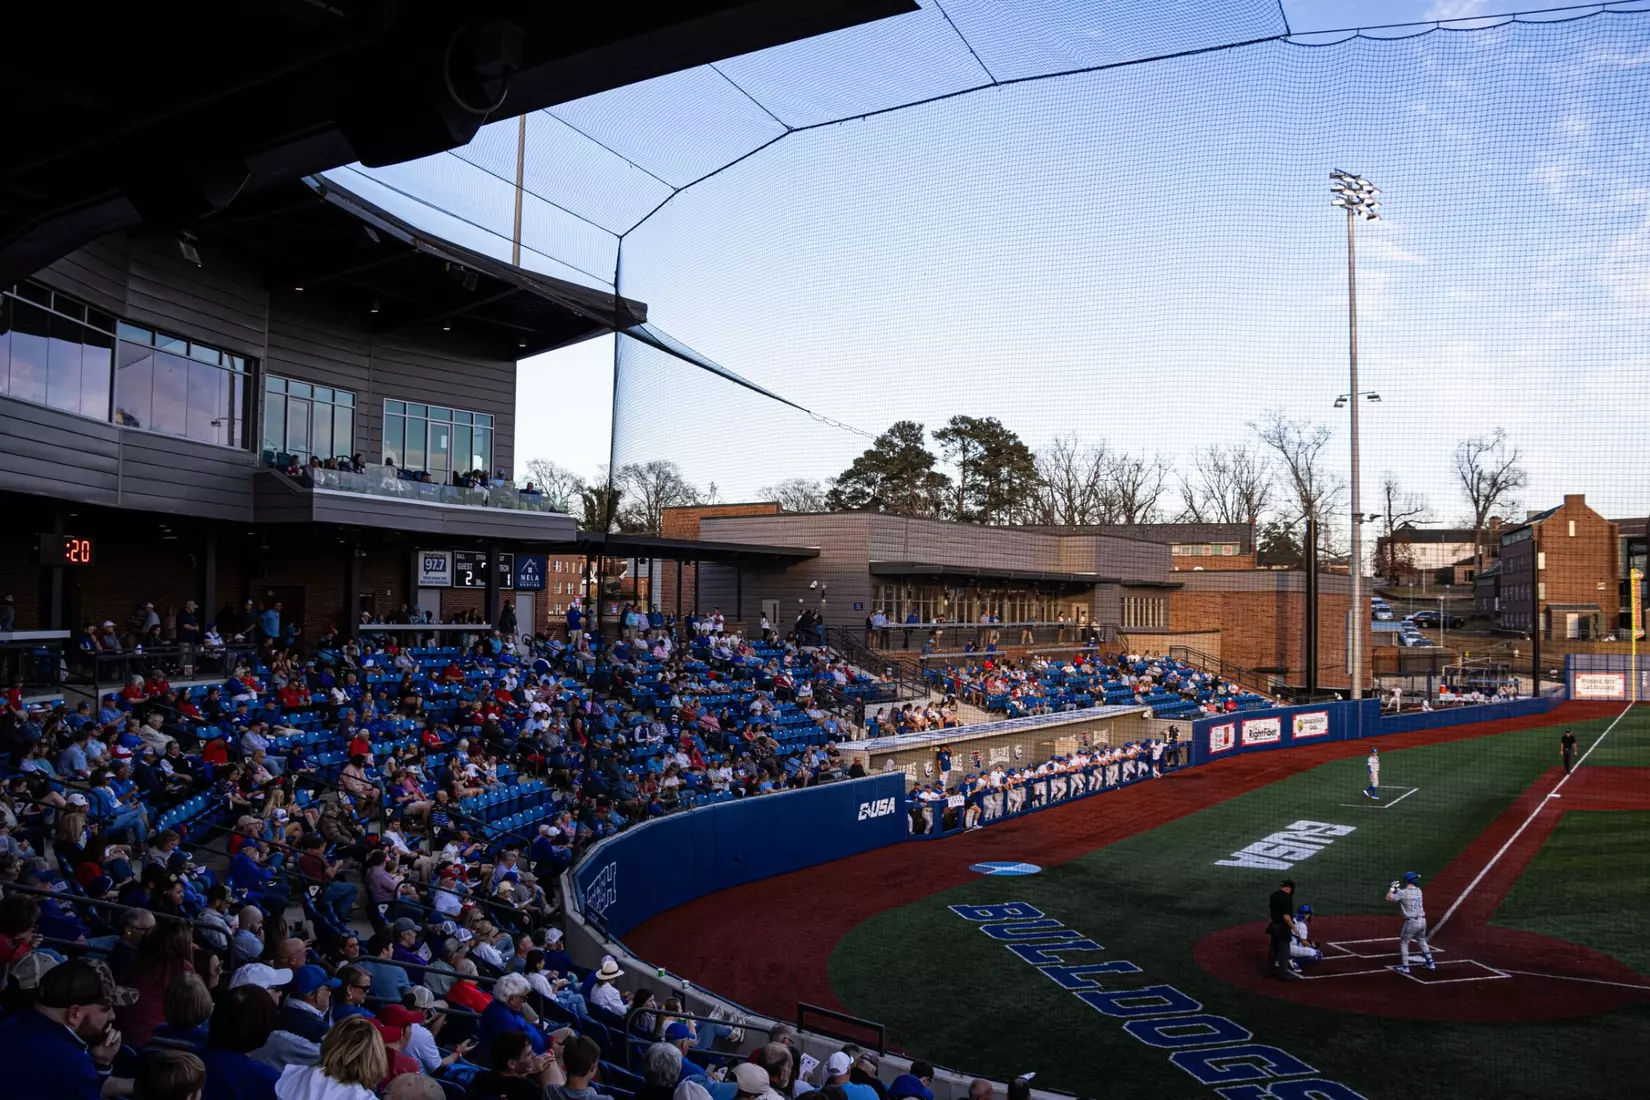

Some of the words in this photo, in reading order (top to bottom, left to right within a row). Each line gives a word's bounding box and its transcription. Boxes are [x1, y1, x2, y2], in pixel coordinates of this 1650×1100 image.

[424, 558, 445, 571] 97.7
[457, 562, 473, 571] GUEST
[465, 570, 473, 586] 2
[507, 573, 511, 586] 1
